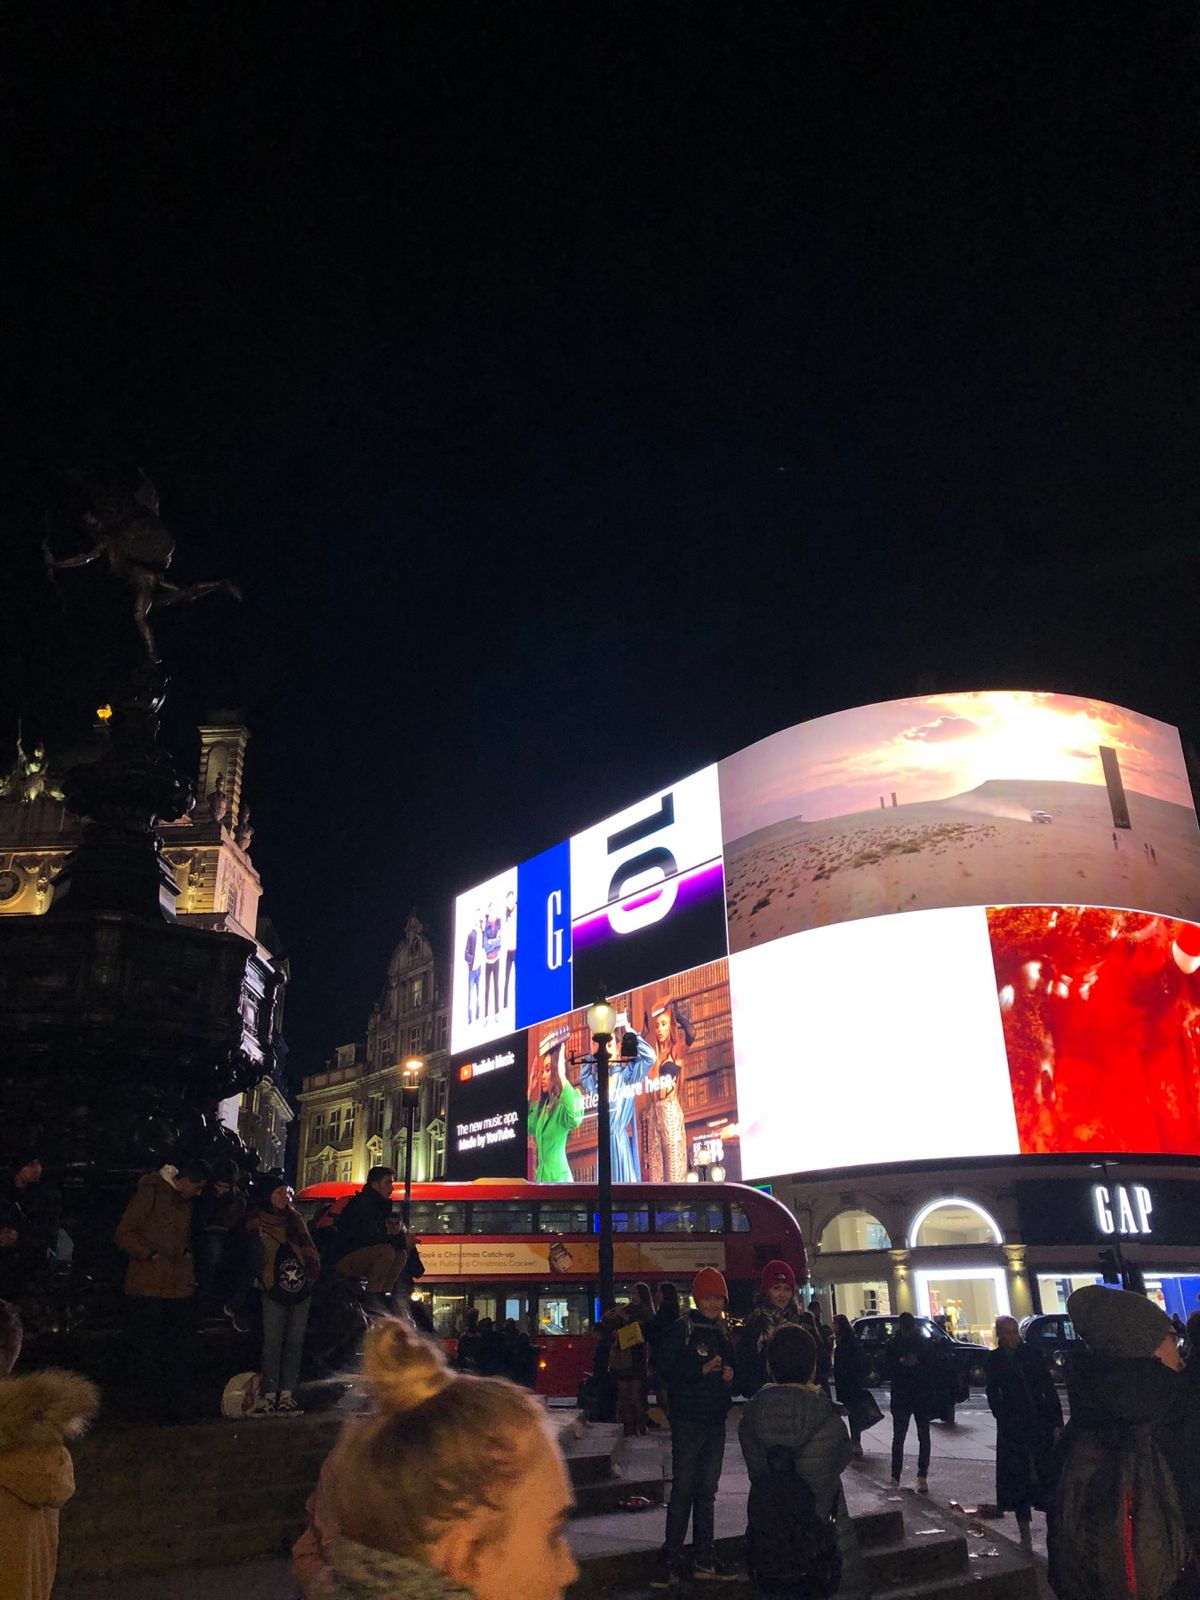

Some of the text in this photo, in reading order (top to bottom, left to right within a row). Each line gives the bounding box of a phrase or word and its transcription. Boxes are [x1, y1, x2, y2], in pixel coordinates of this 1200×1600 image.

[495, 1051, 515, 1069] Music
[574, 1093, 599, 1112] Little
[457, 1112, 519, 1136] The new music app.
[459, 1136, 477, 1151] Made
[477, 1134, 486, 1148] by
[1094, 1185, 1153, 1234] GAP
